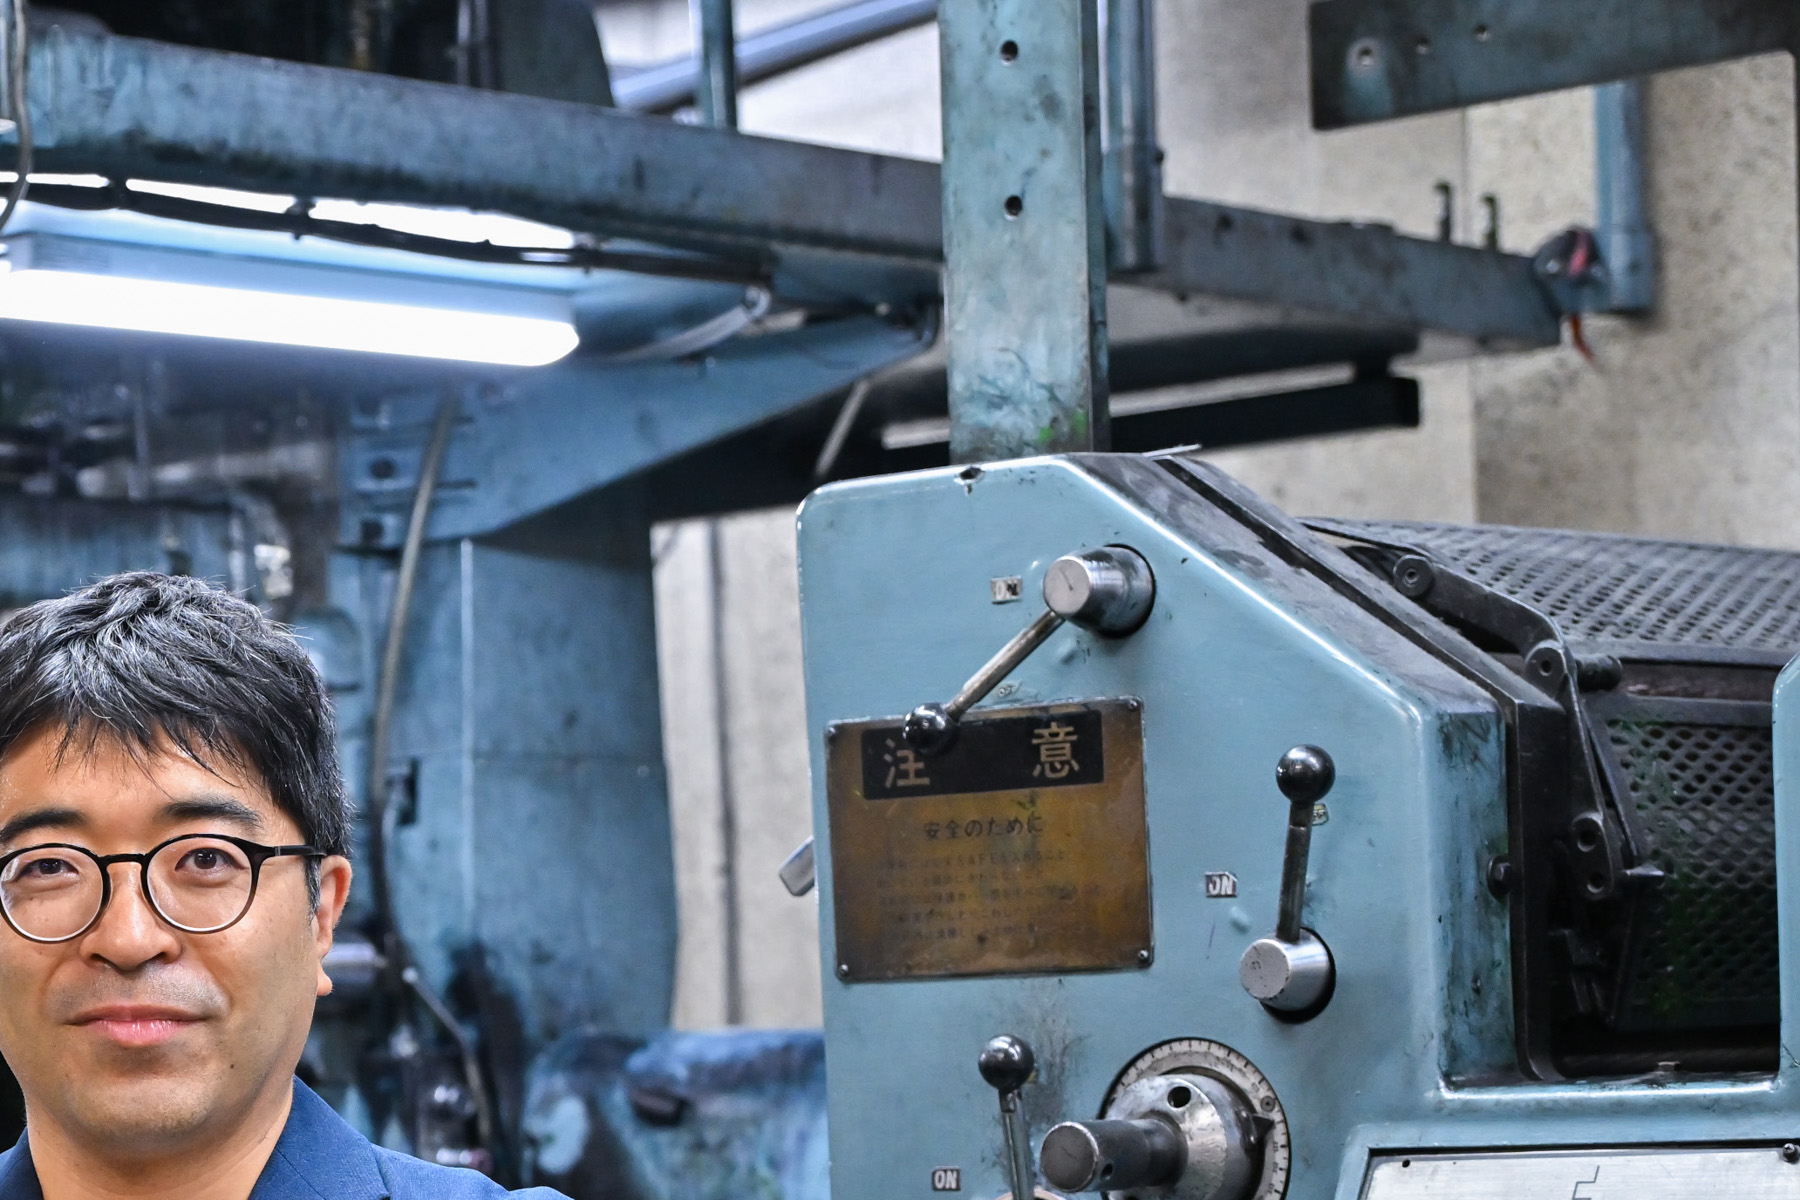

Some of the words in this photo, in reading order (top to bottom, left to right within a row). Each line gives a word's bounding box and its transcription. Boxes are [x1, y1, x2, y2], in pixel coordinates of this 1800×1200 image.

[923, 812, 1044, 841] 安全のために
[1208, 875, 1234, 896] ON
[933, 1169, 958, 1189] ON
